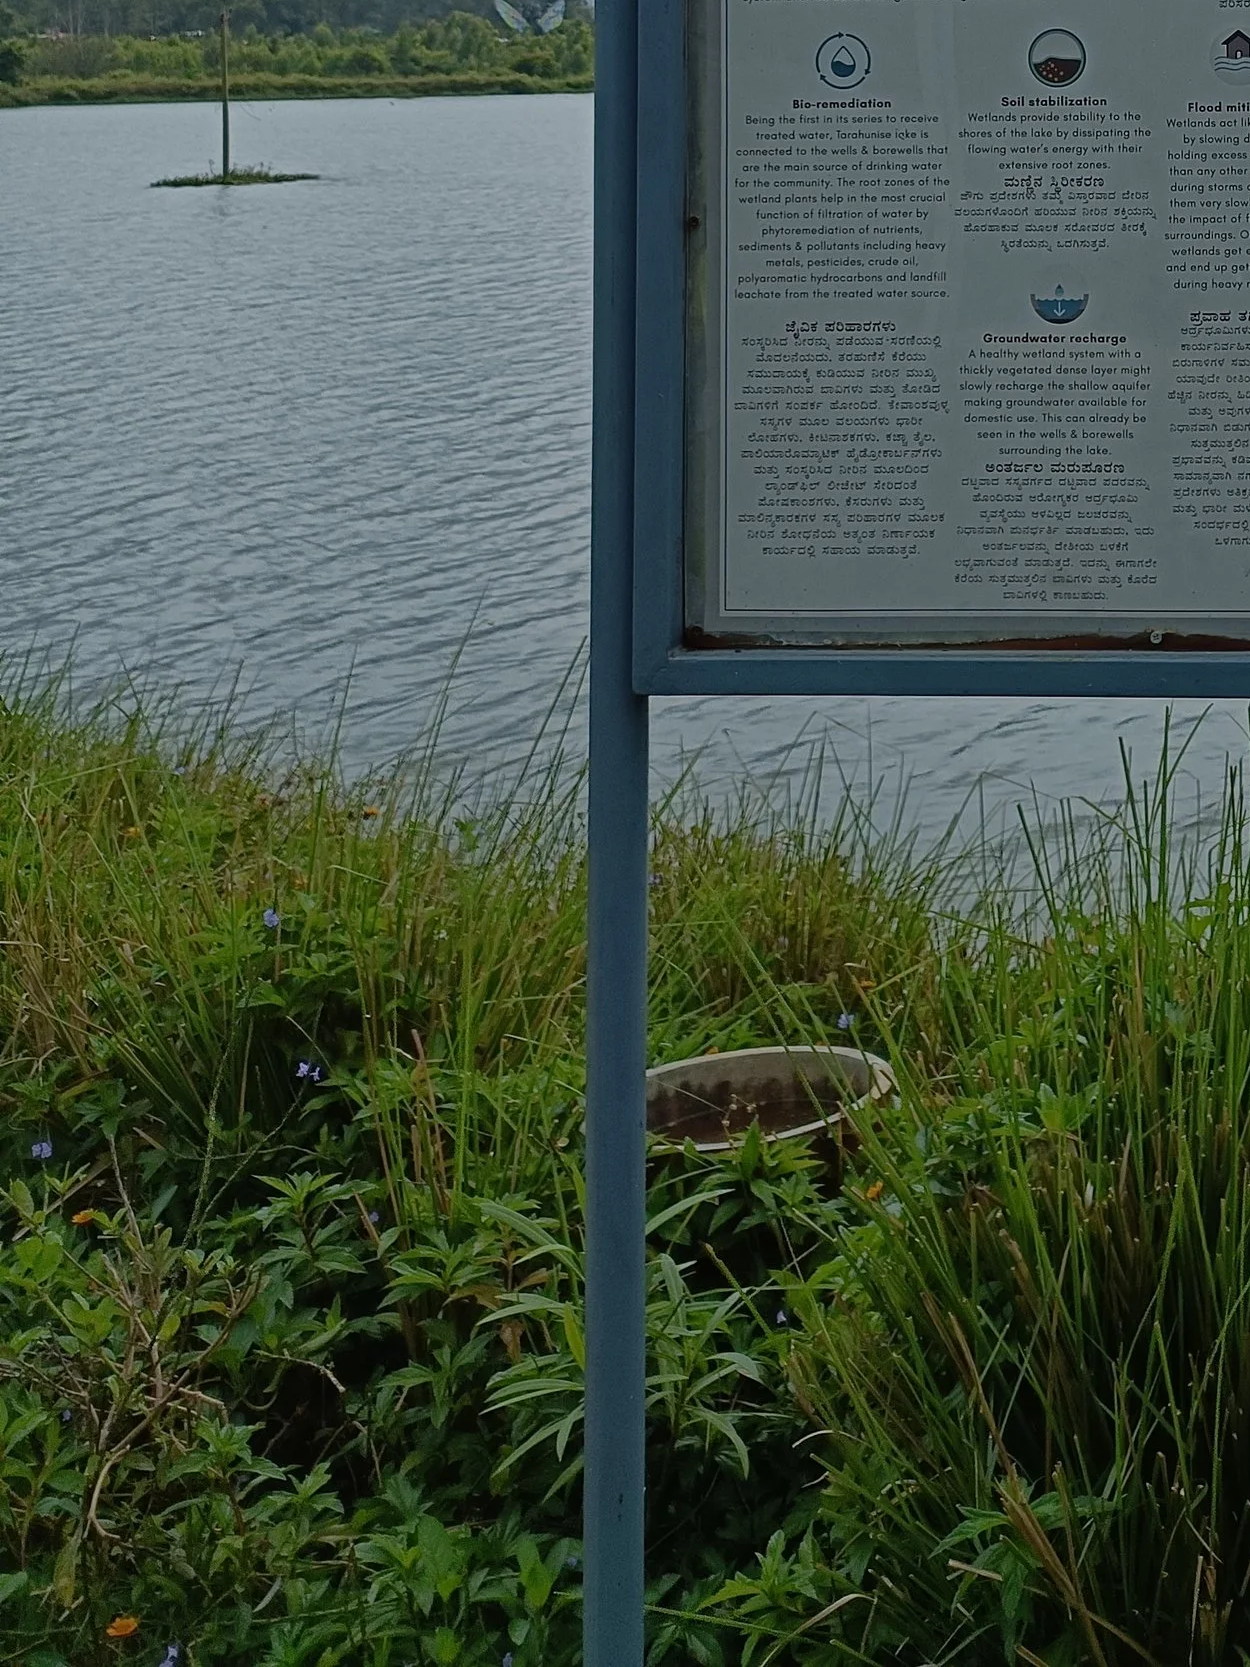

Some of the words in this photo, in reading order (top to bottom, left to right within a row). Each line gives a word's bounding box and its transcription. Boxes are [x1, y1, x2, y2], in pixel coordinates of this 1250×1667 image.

[793, 98, 891, 109] Bio-remediation
[1002, 96, 1024, 106] Soil
[1029, 96, 1106, 106] stabilization
[1189, 102, 1221, 112] Flood
[1168, 150, 1207, 162] holding
[999, 161, 1047, 170] extensive
[1052, 161, 1073, 169] root
[762, 225, 855, 238] phytoremediation
[874, 225, 922, 235] nutrients,
[984, 332, 1065, 343] Groundwater
[1070, 333, 1126, 345] recharge
[999, 445, 1061, 458] surrounding
[1066, 446, 1082, 455] the
[1087, 445, 1111, 454] lake.
